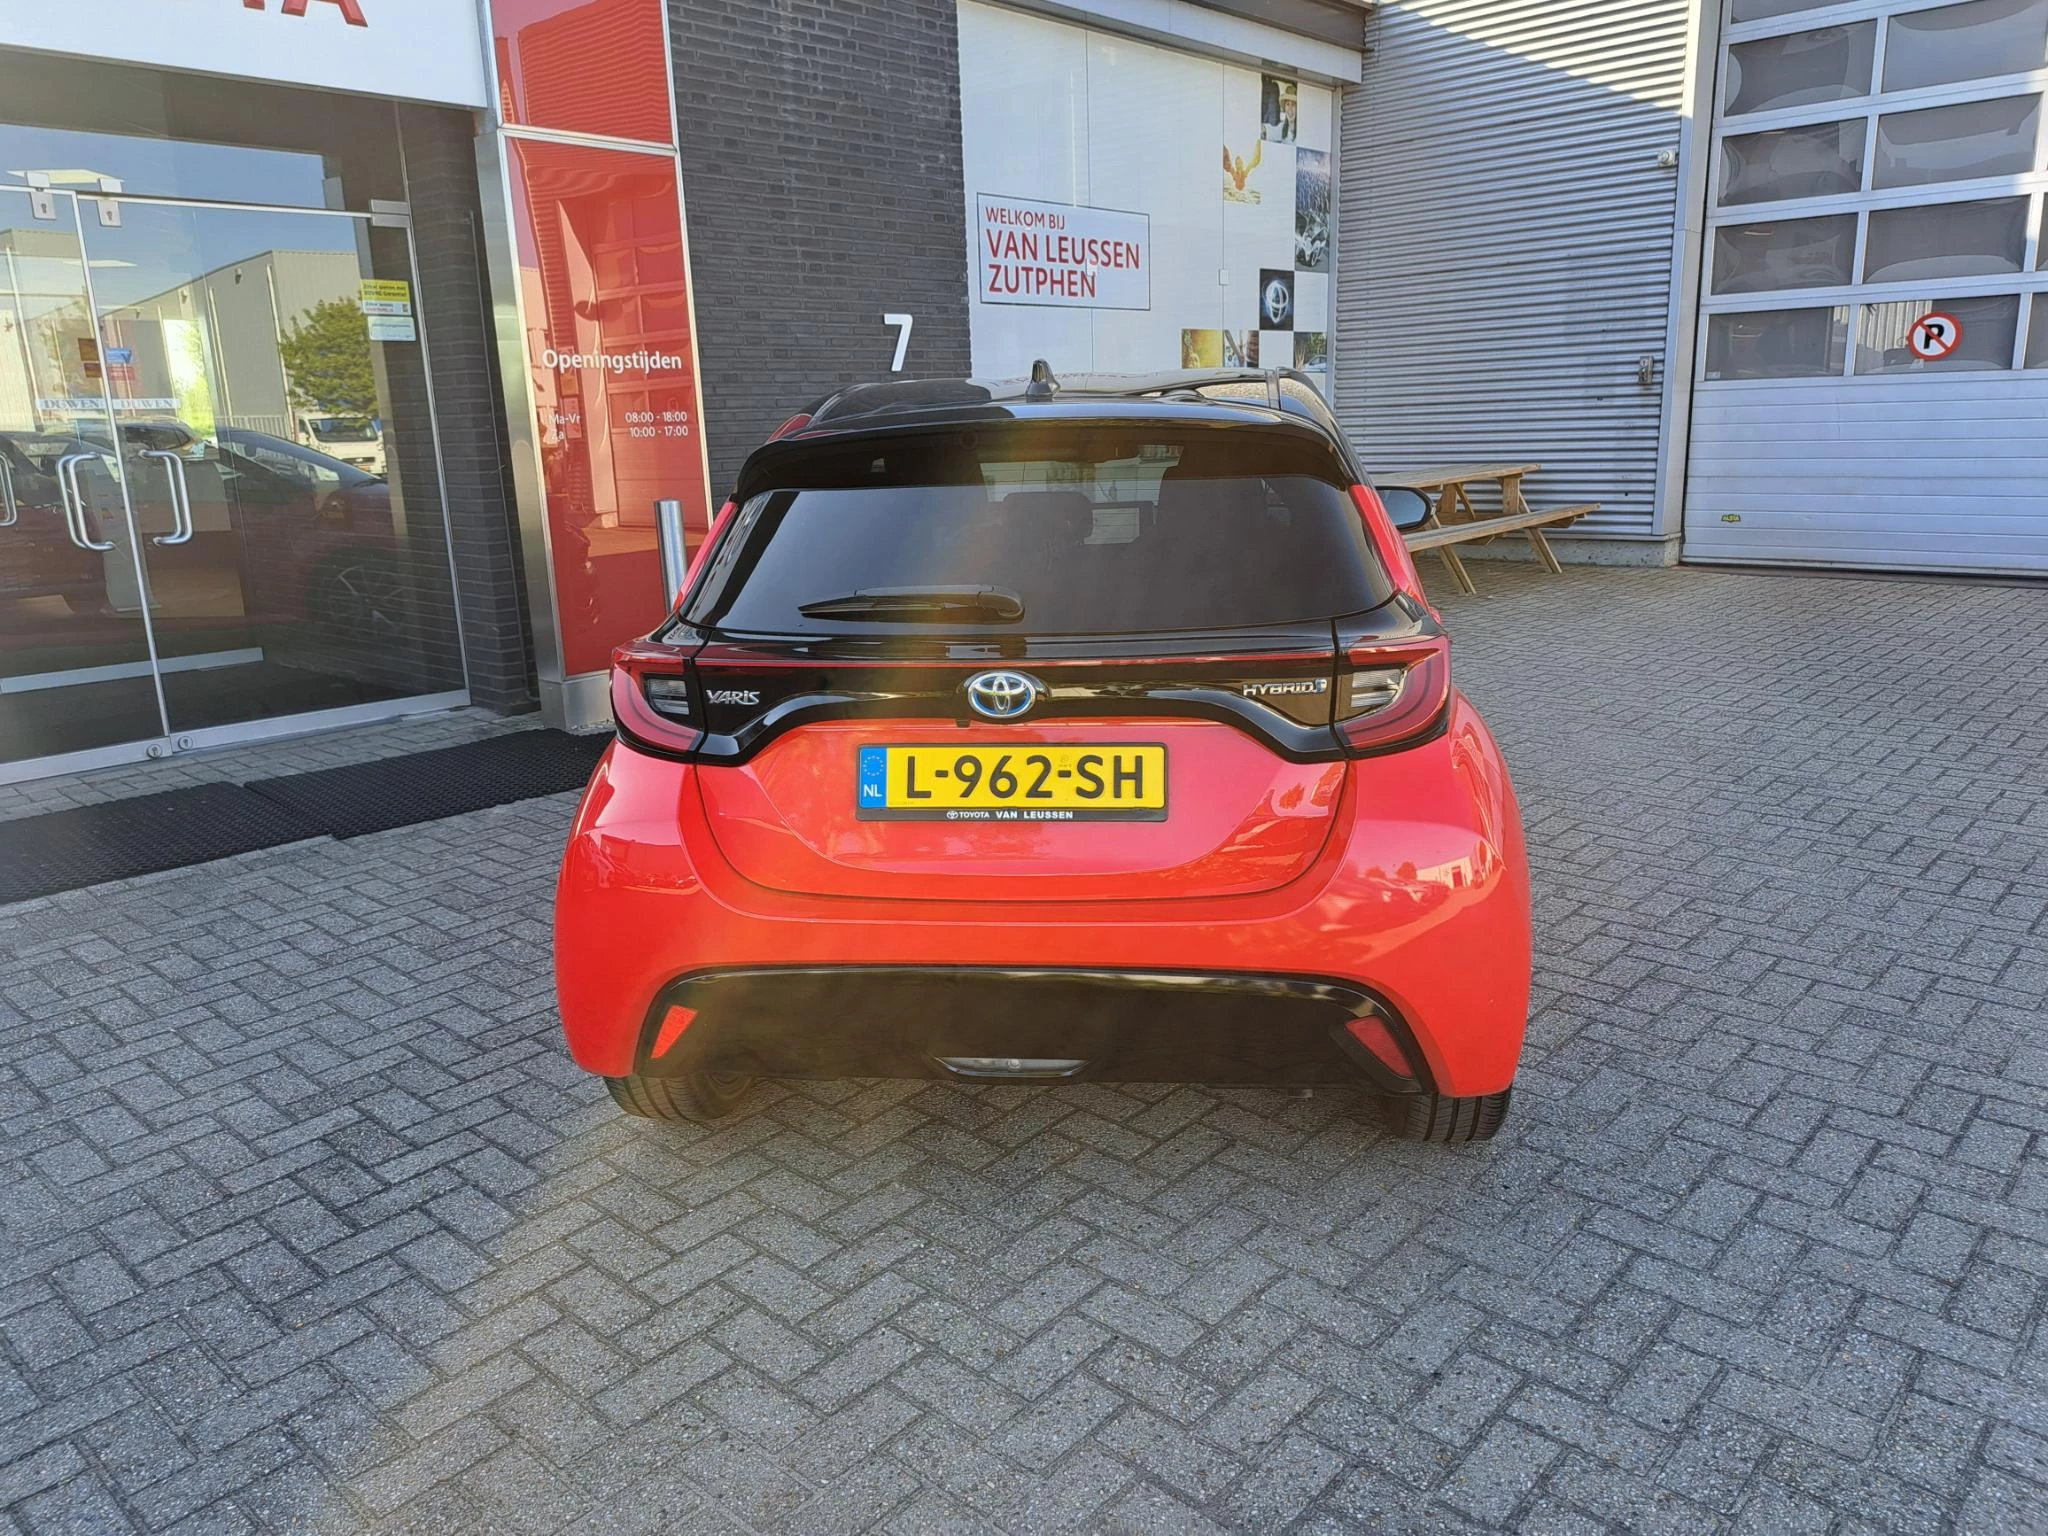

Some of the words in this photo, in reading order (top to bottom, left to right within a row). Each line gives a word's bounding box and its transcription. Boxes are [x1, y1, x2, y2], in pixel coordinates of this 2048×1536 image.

[985, 206, 1045, 228] WELKOM
[1048, 214, 1065, 230] BIJ
[986, 228, 1038, 261] VAN
[1045, 234, 1140, 270] LEUSSEN
[988, 263, 1096, 298] ZUTPHEN
[884, 313, 913, 372] 7
[542, 349, 682, 374] Openingstijden
[44, 399, 98, 409] DUWEN
[120, 399, 173, 408] DUWEN
[549, 413, 581, 425] Ma-Vr
[625, 412, 654, 424] 08:00
[662, 411, 688, 423] 18:00
[630, 426, 656, 438] 10:00
[664, 425, 688, 437] 17:00
[1242, 681, 1314, 696] HYBRID
[863, 783, 882, 798] NL
[906, 754, 1144, 799] L-962-SH
[959, 811, 990, 819] TOYOTA
[996, 811, 1018, 819] VAN
[1023, 811, 1074, 819] LEUSSEN
